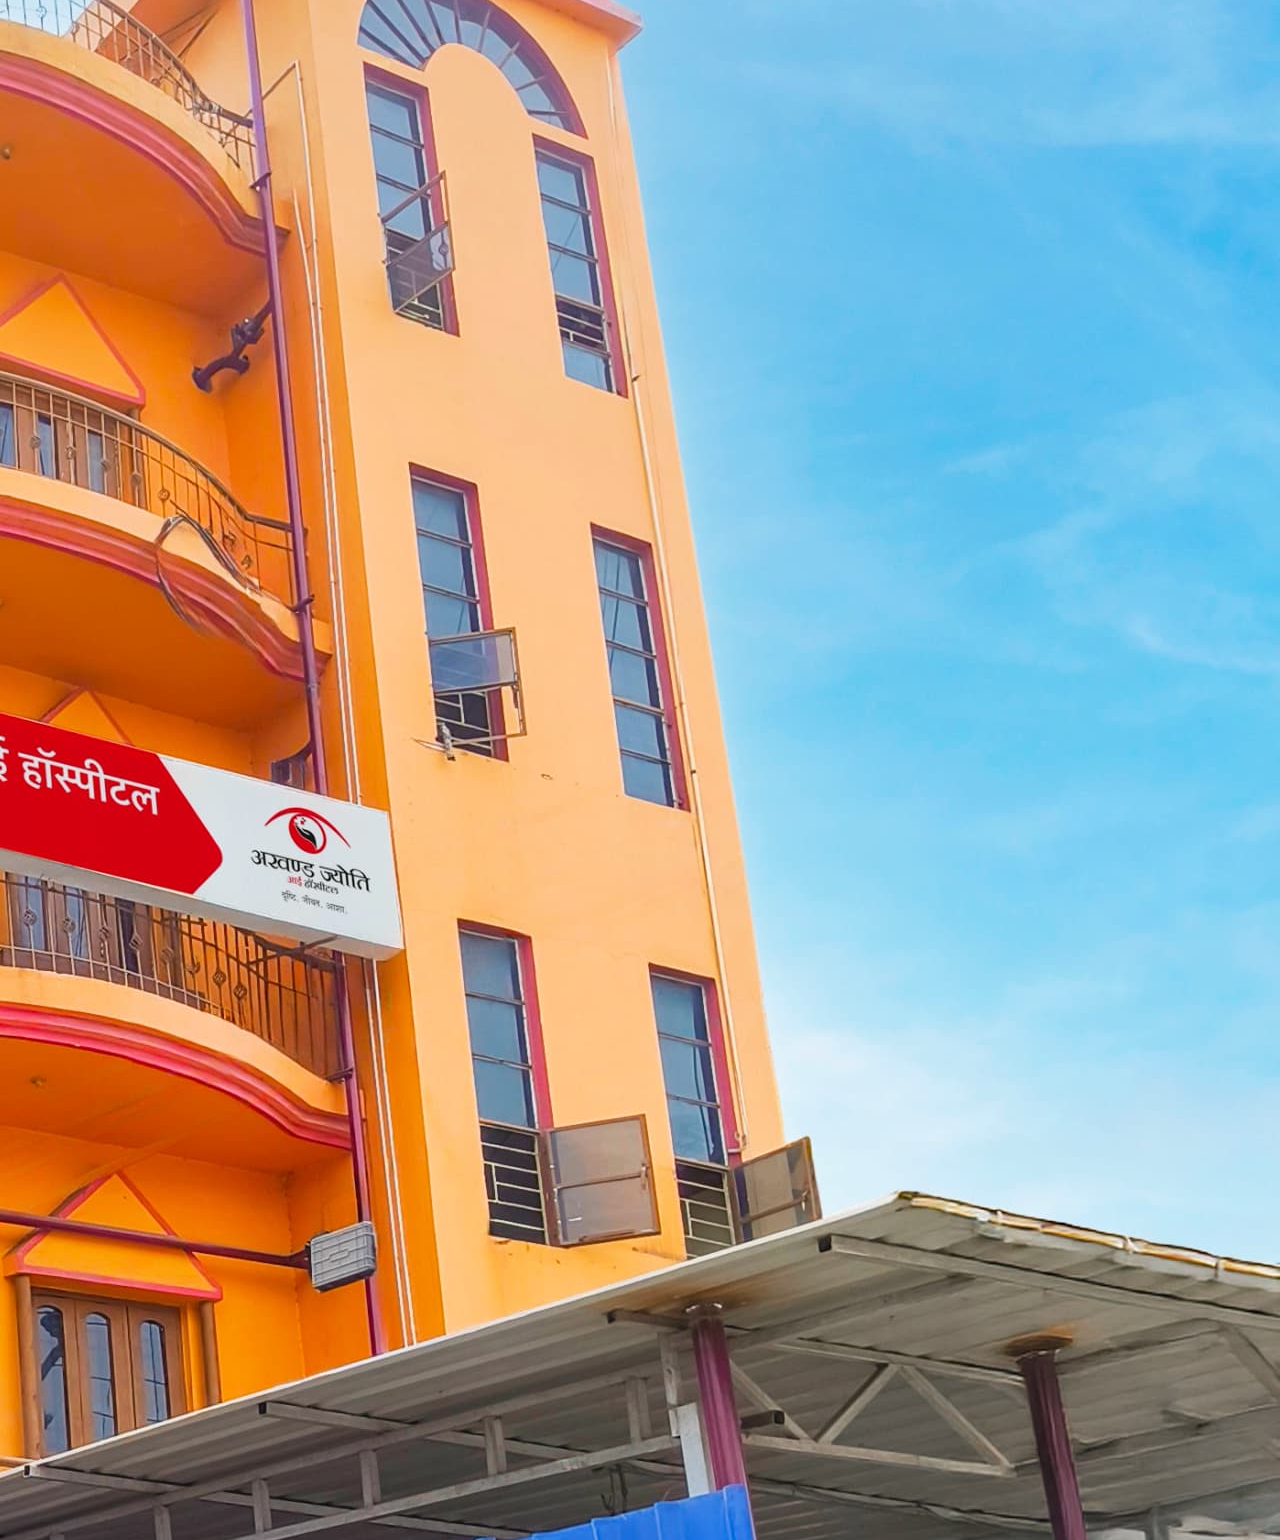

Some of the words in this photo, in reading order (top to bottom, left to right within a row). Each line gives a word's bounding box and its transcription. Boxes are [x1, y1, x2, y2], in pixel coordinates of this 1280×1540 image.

[18, 747, 160, 815] हॉस्पीटल
[251, 850, 316, 878] अखण्ड
[319, 864, 371, 893] ज्योति
